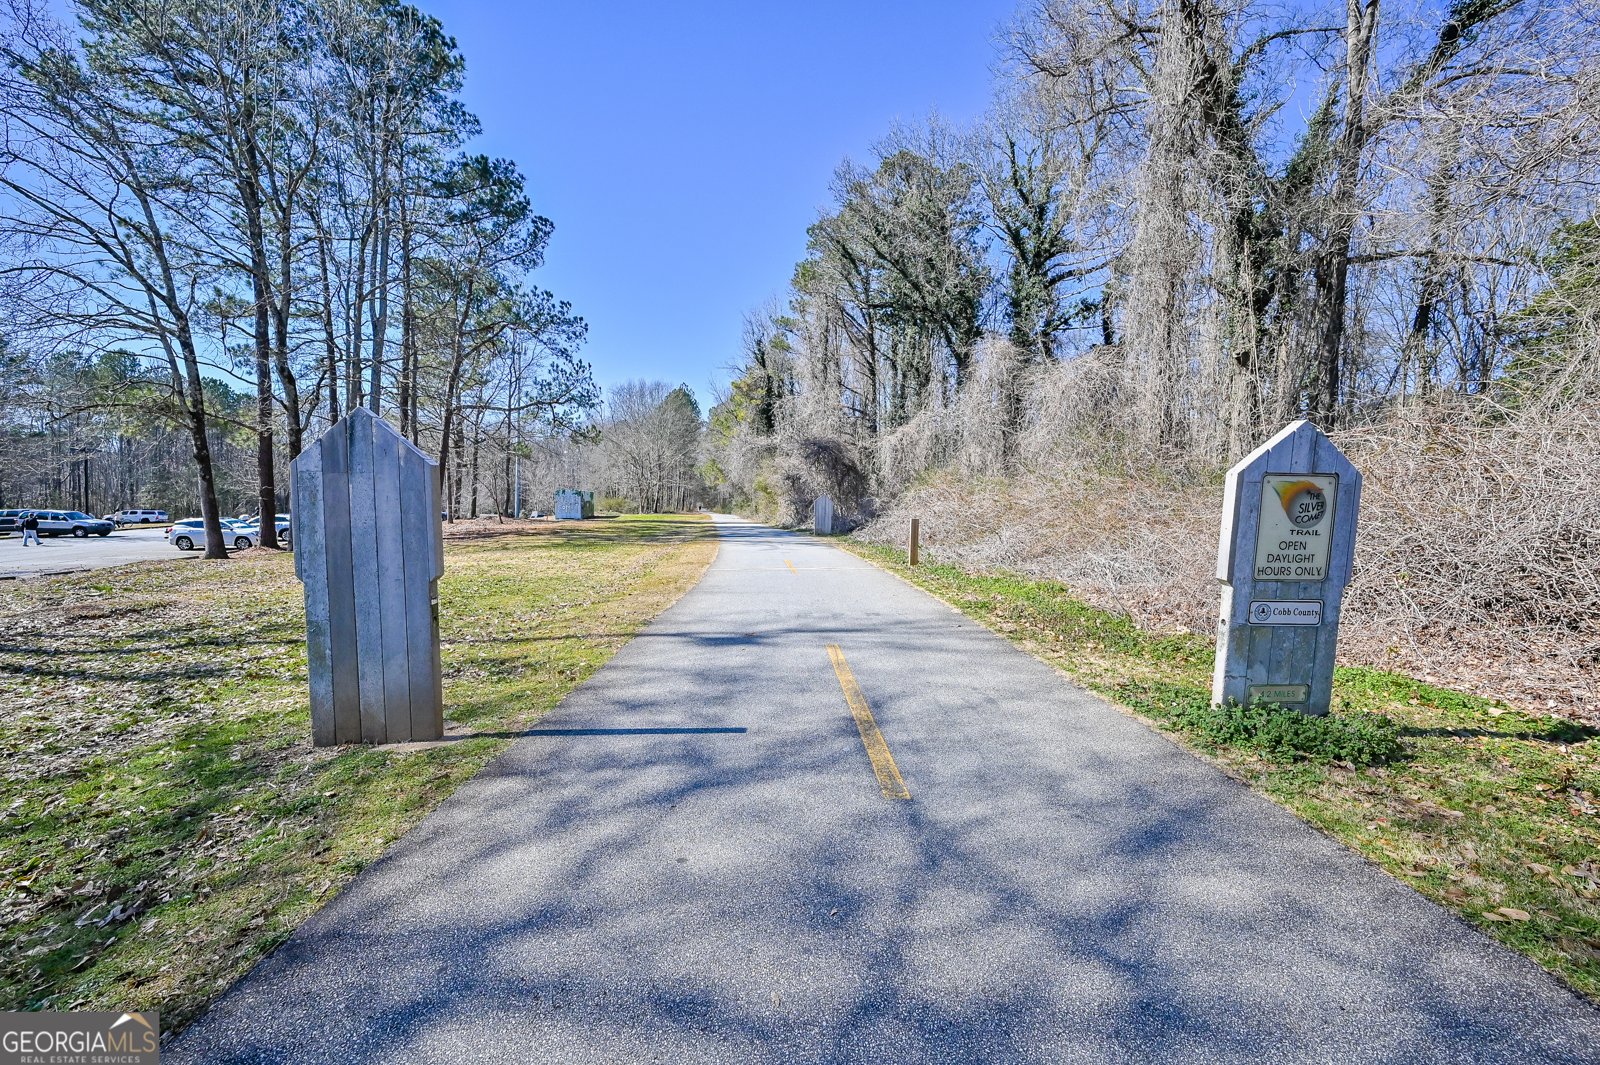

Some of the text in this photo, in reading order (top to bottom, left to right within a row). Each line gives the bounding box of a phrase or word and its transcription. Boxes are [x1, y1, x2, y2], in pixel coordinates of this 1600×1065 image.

[1295, 511, 1324, 524] COMET
[1279, 541, 1306, 550] OPEN
[1267, 554, 1315, 563] DAYLIGHT
[1257, 567, 1322, 576] HOURS ONLY
[1294, 608, 1318, 618] County
